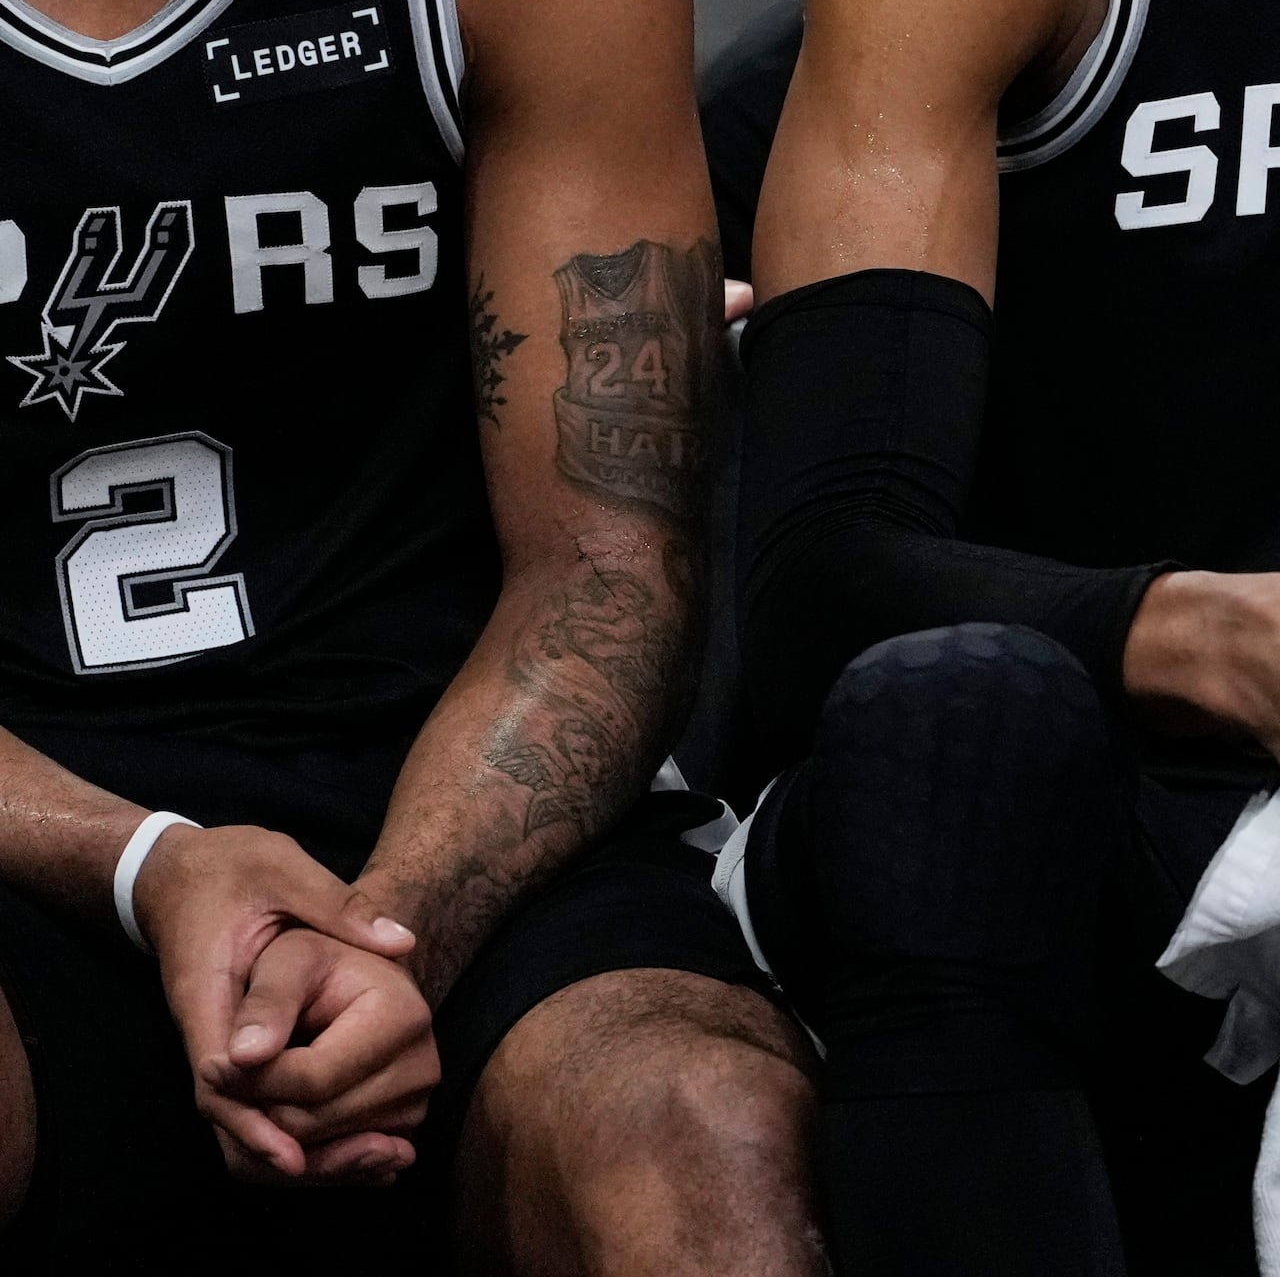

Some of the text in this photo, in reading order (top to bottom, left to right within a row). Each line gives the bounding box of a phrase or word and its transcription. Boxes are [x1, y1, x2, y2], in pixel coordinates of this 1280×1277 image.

[230, 30, 362, 81] LEDGER
[585, 334, 671, 399] 24
[50, 430, 255, 676] 2
